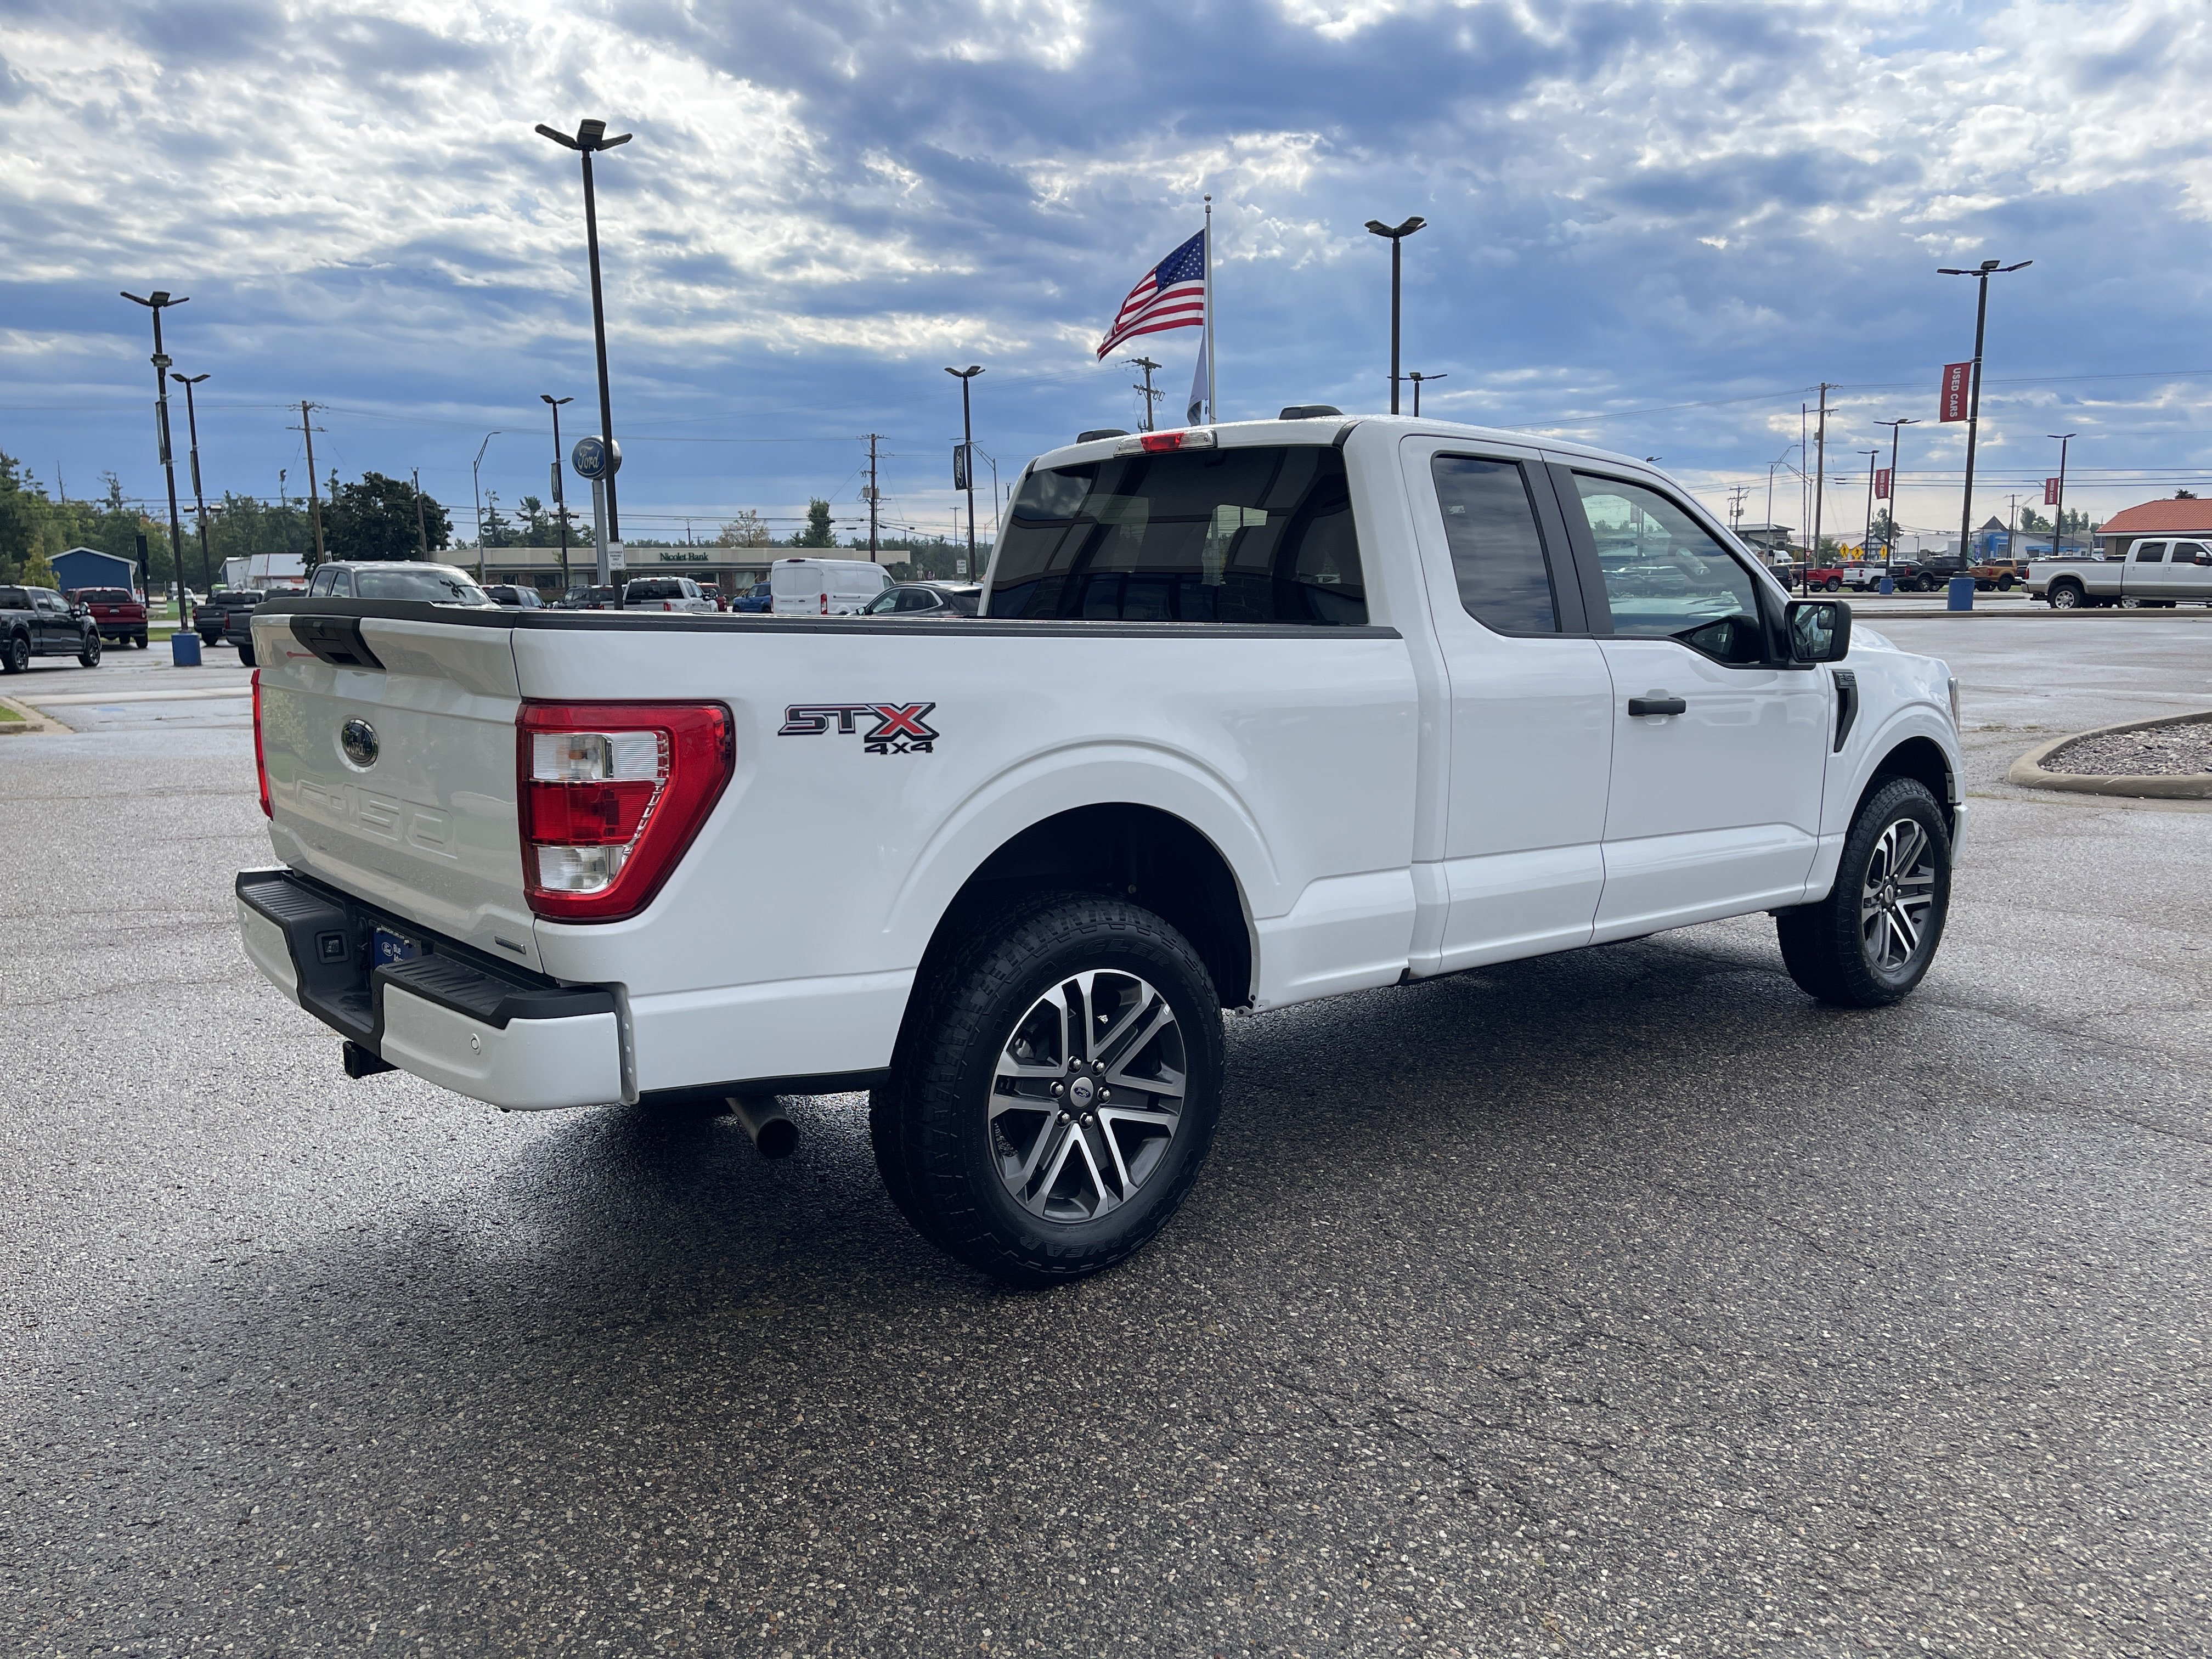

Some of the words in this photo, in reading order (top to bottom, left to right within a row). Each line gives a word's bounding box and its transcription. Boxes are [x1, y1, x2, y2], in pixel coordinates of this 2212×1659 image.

[1950, 367, 1961, 391] USED
[1949, 393, 1959, 417] CARS
[578, 445, 600, 470] Ford
[660, 552, 686, 561] Nicolet
[689, 552, 709, 561] Bank
[778, 702, 940, 743] STX
[294, 768, 459, 860] F-150
